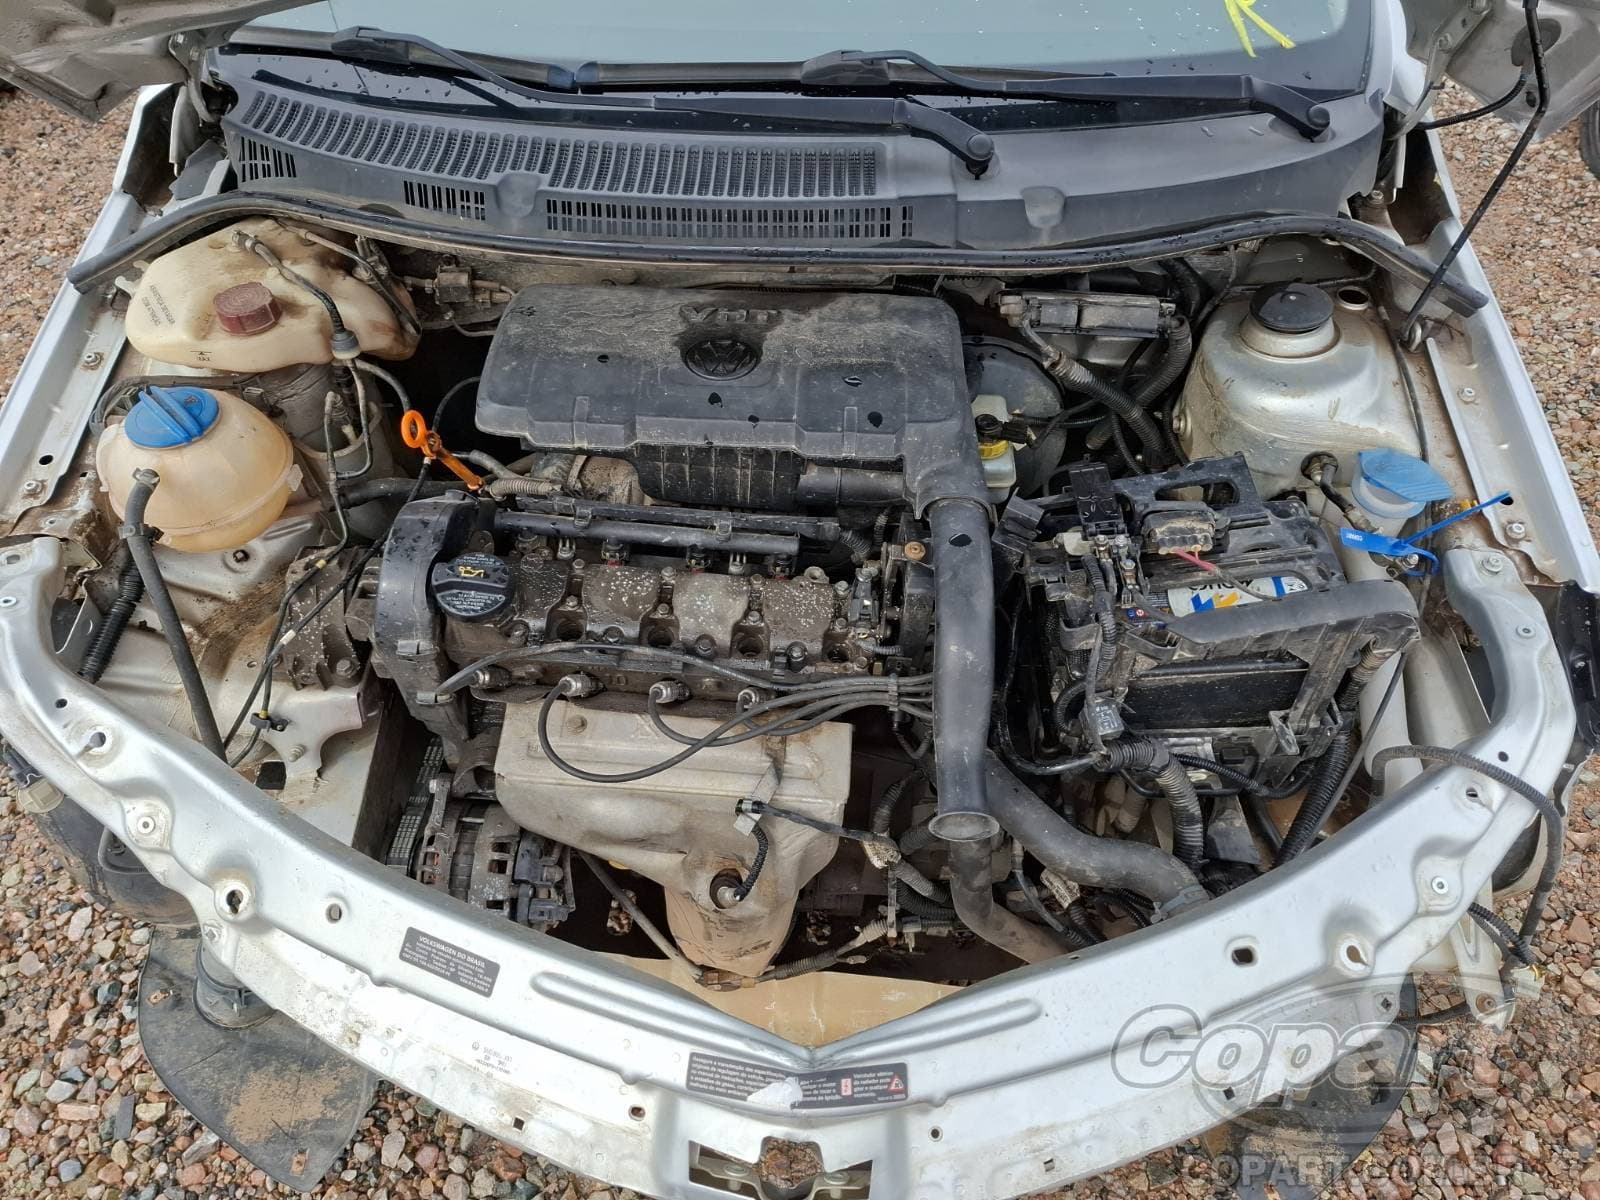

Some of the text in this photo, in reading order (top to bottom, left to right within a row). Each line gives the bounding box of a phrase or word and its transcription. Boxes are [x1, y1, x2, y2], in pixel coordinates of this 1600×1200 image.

[419, 935, 457, 956] VOLKSWAGEN
[457, 951, 467, 960] DO
[466, 954, 485, 968] BRASIL
